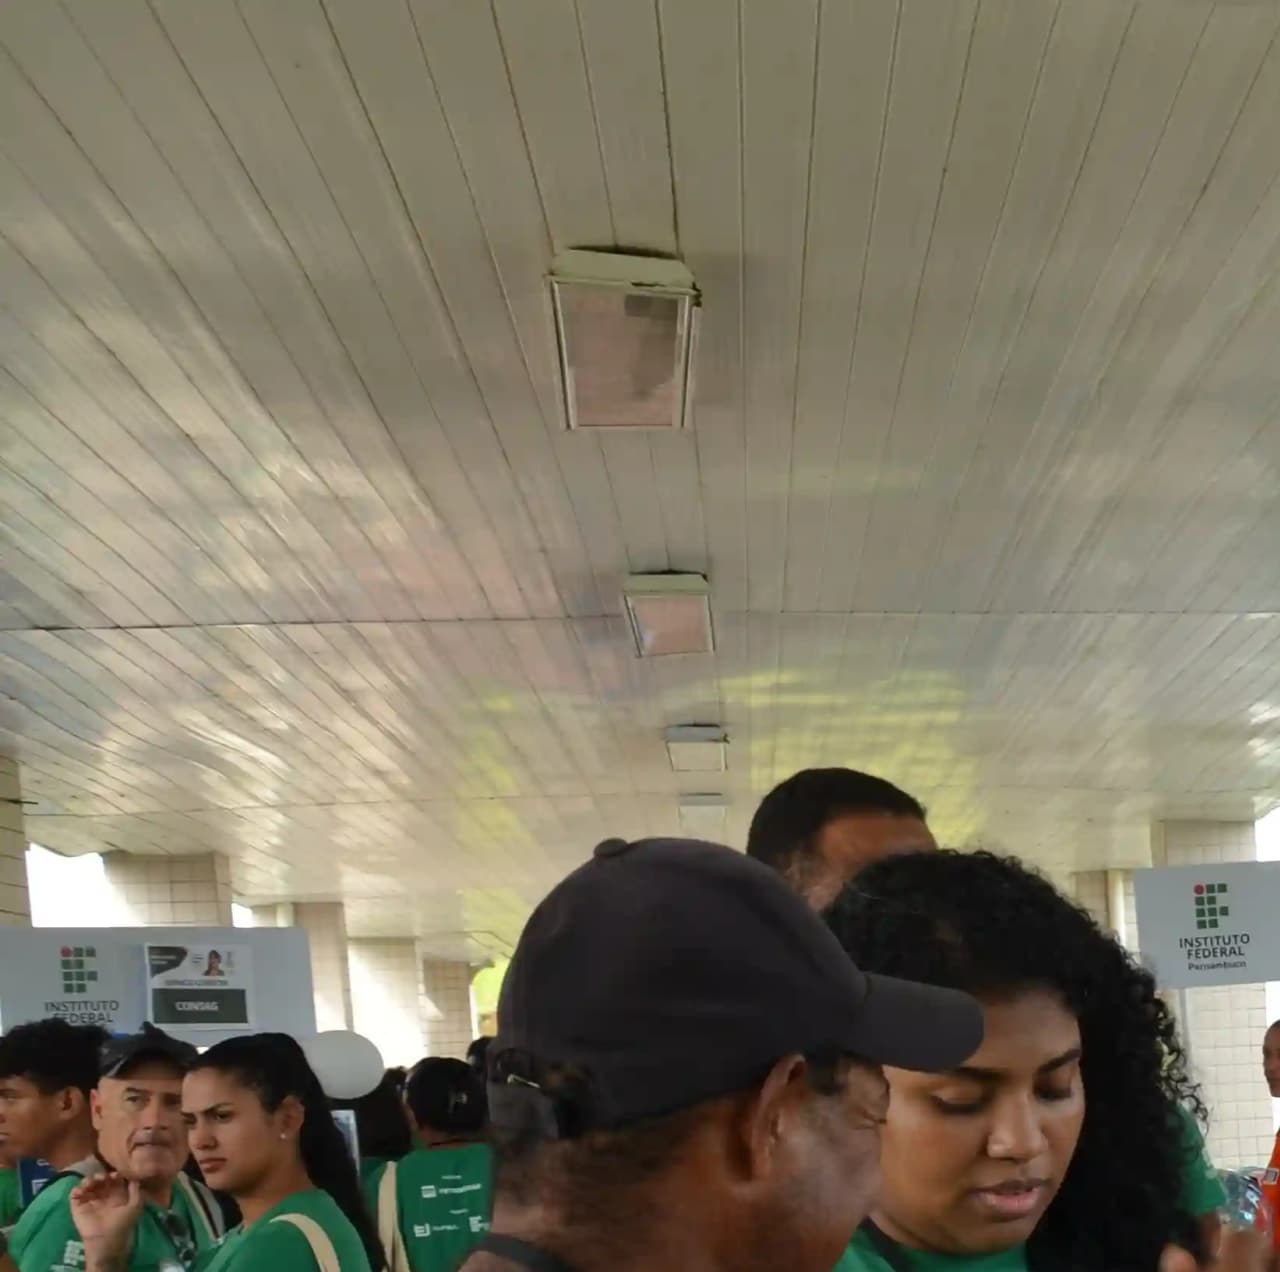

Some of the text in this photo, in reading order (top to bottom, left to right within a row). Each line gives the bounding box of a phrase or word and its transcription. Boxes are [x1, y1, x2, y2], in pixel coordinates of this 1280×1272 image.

[1179, 933, 1250, 949] INSTITUTO
[1187, 947, 1245, 960] FEDERAL
[1188, 960, 1247, 971] Pernambuco
[45, 1000, 119, 1013] INSTITUTO
